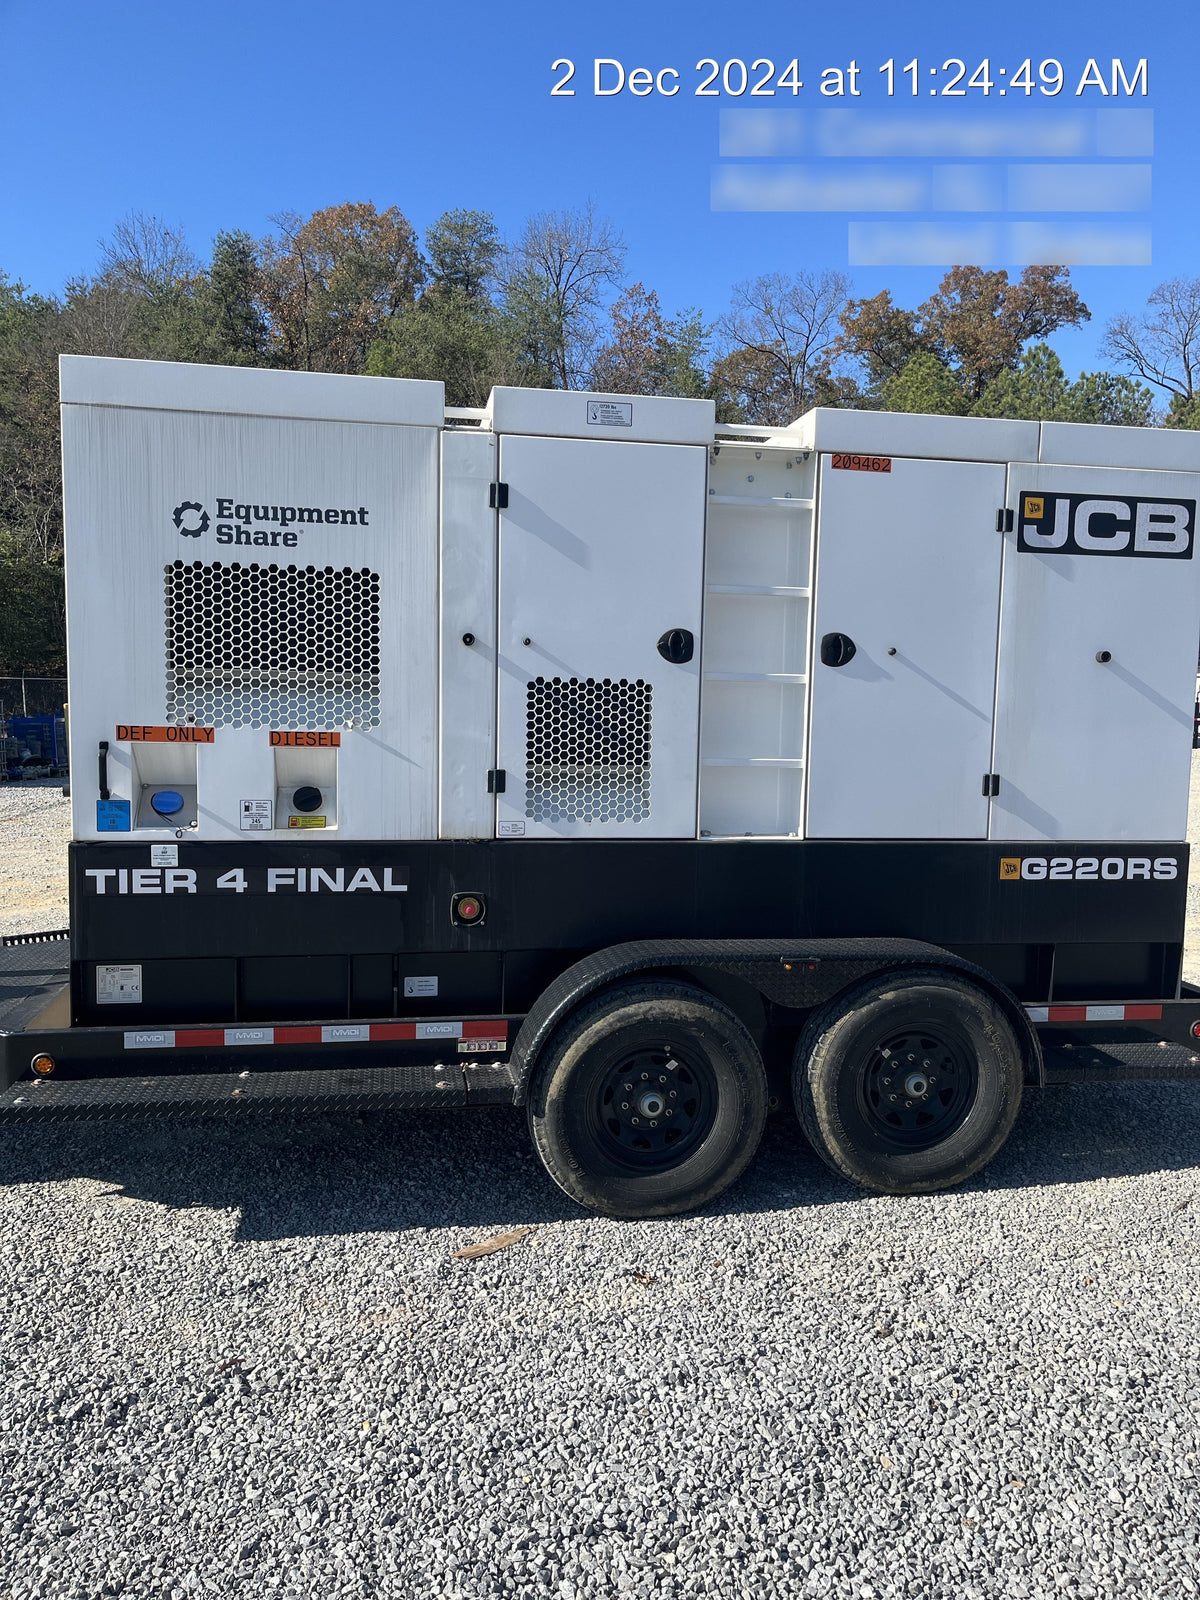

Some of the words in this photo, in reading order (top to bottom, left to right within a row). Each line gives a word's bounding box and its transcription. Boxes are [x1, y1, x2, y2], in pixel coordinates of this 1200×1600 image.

[833, 454, 891, 472] 209462
[216, 498, 369, 526] Equipment
[1028, 501, 1041, 514] JCB
[216, 524, 298, 547] Share
[1023, 498, 1190, 553] JCB
[117, 725, 153, 741] DEF
[166, 727, 214, 743] ONLY
[270, 731, 341, 746] DIESEL
[1002, 862, 1019, 876] JCB
[1021, 857, 1178, 880] G220RS
[85, 868, 197, 894] TIER
[216, 868, 248, 893] 4
[267, 867, 408, 892] FINAL
